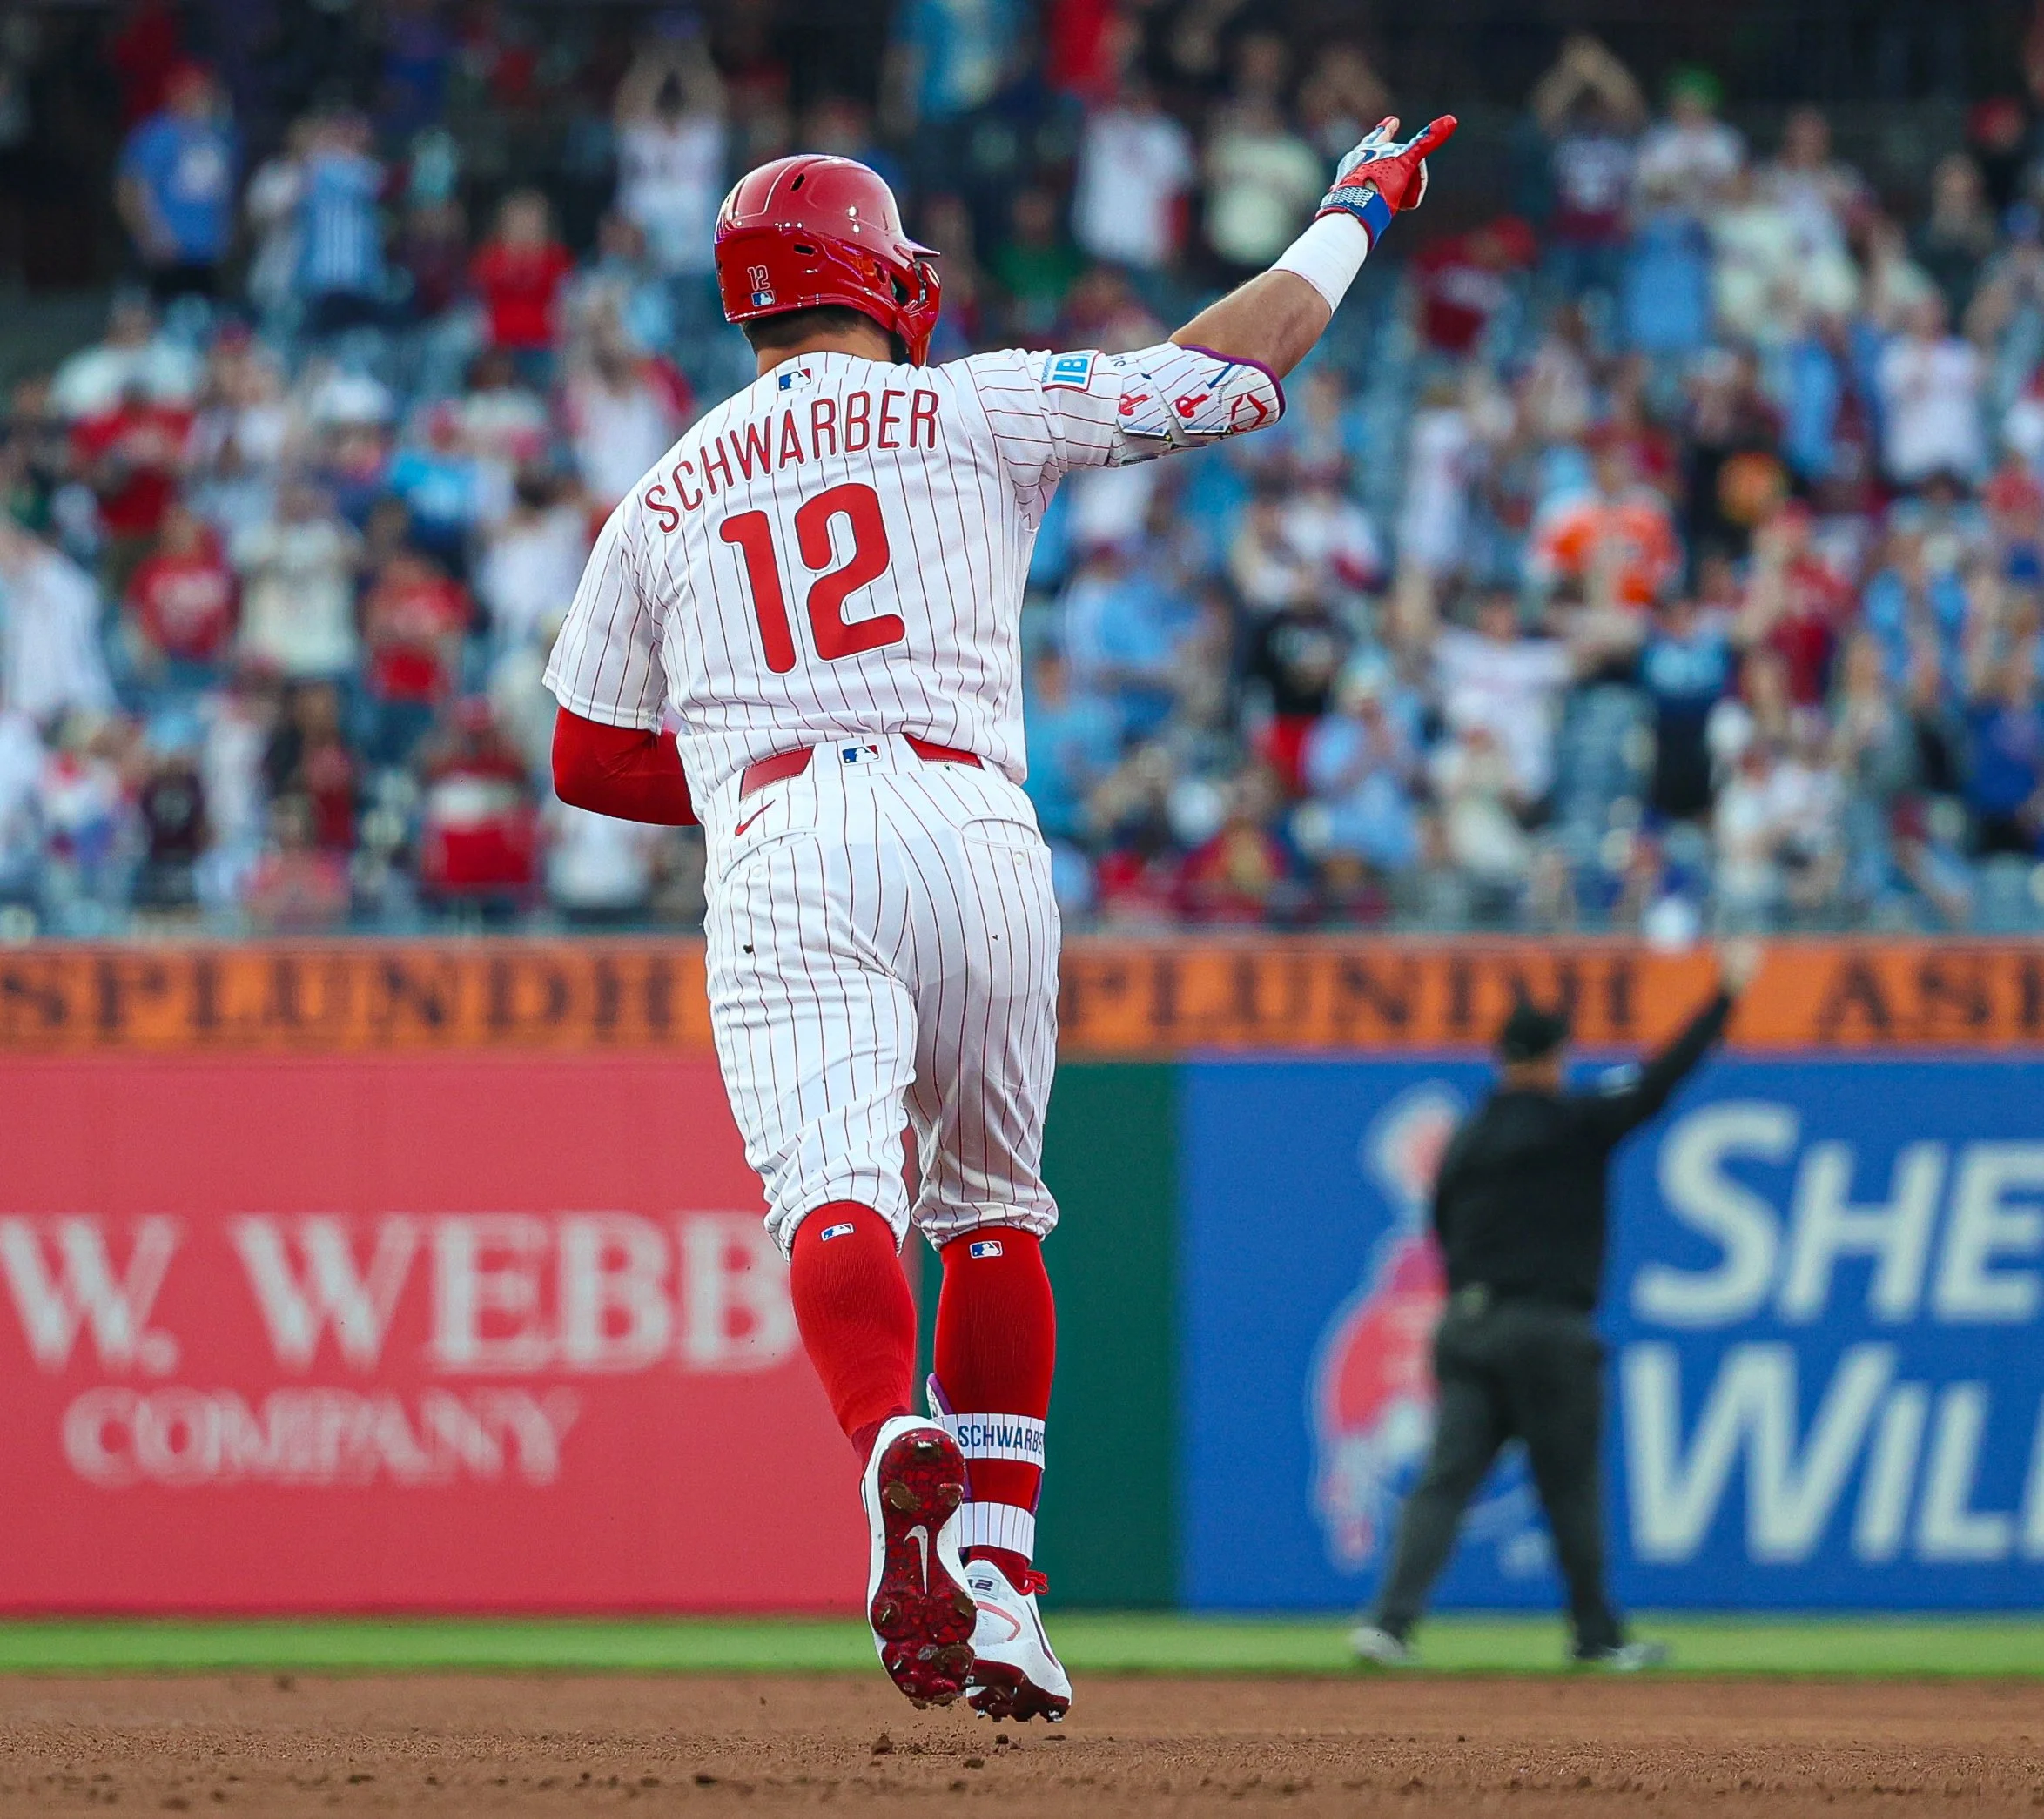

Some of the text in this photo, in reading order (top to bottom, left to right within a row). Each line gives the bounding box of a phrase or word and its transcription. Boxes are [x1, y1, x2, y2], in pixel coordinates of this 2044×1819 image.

[747, 265, 770, 292] 12
[1052, 352, 1090, 385] IB
[644, 389, 939, 534] SCHWARBER
[719, 482, 906, 675] 12
[0, 1212, 799, 1377] W. WEBB
[61, 1386, 585, 1488] COMPANY
[958, 1425, 1044, 1455] SCHWARBE
